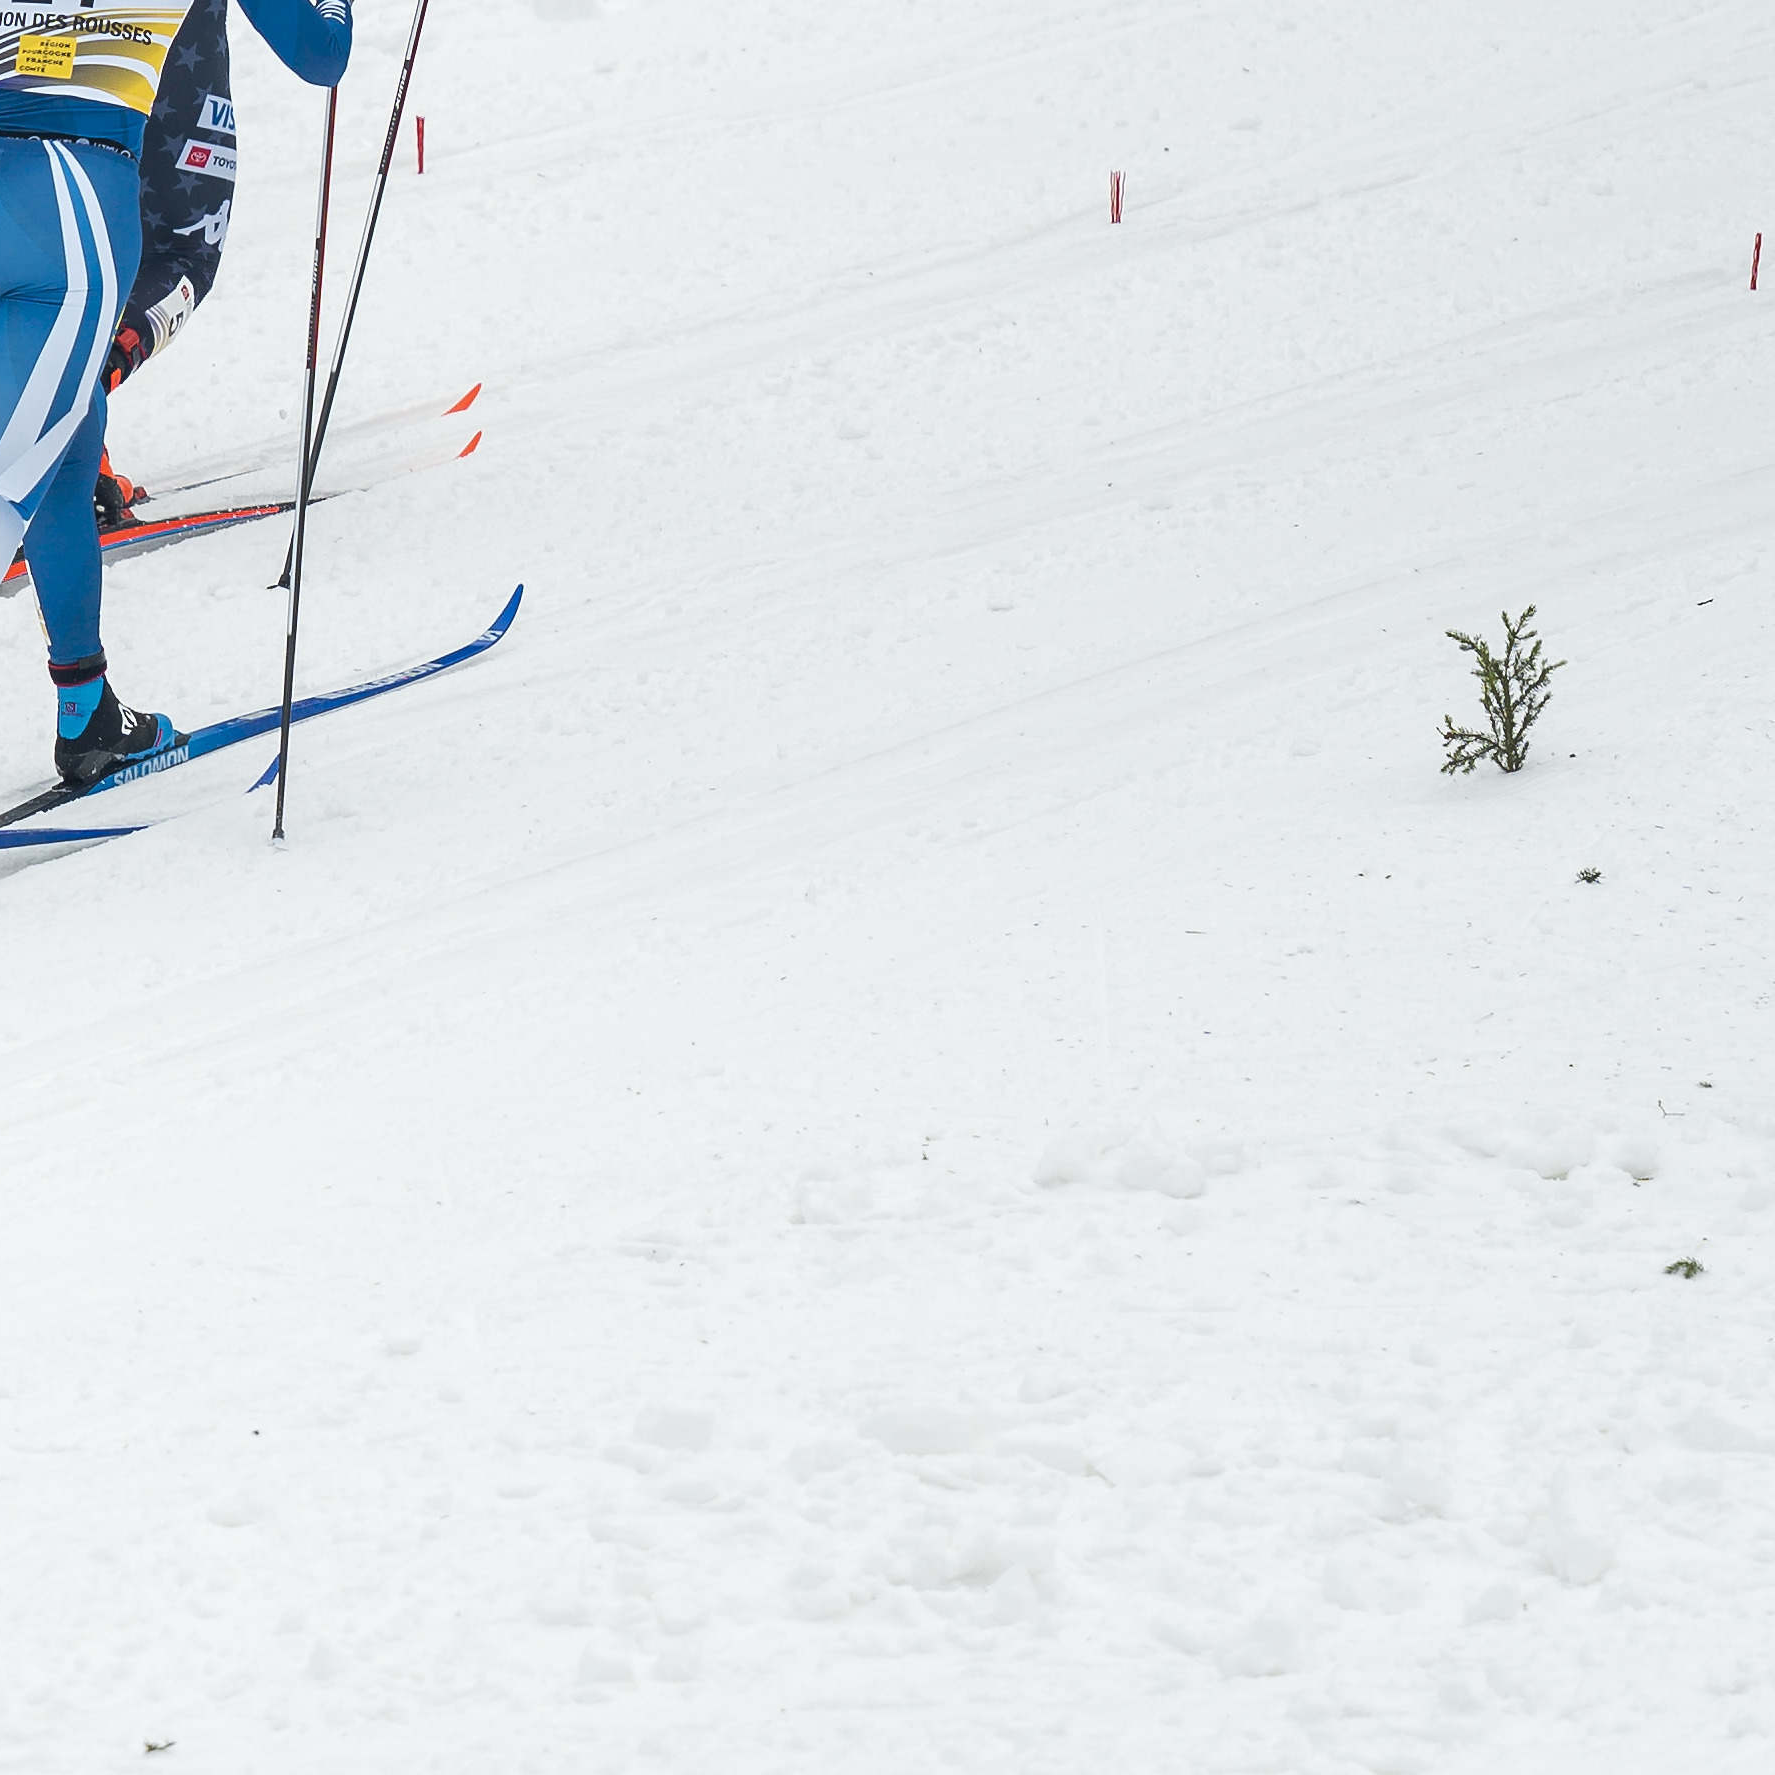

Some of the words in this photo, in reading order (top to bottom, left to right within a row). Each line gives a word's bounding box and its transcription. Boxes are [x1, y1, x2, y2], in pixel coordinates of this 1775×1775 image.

[33, 12, 70, 30] DES
[73, 14, 153, 46] ROUSSES
[113, 745, 189, 785] SALOMON
